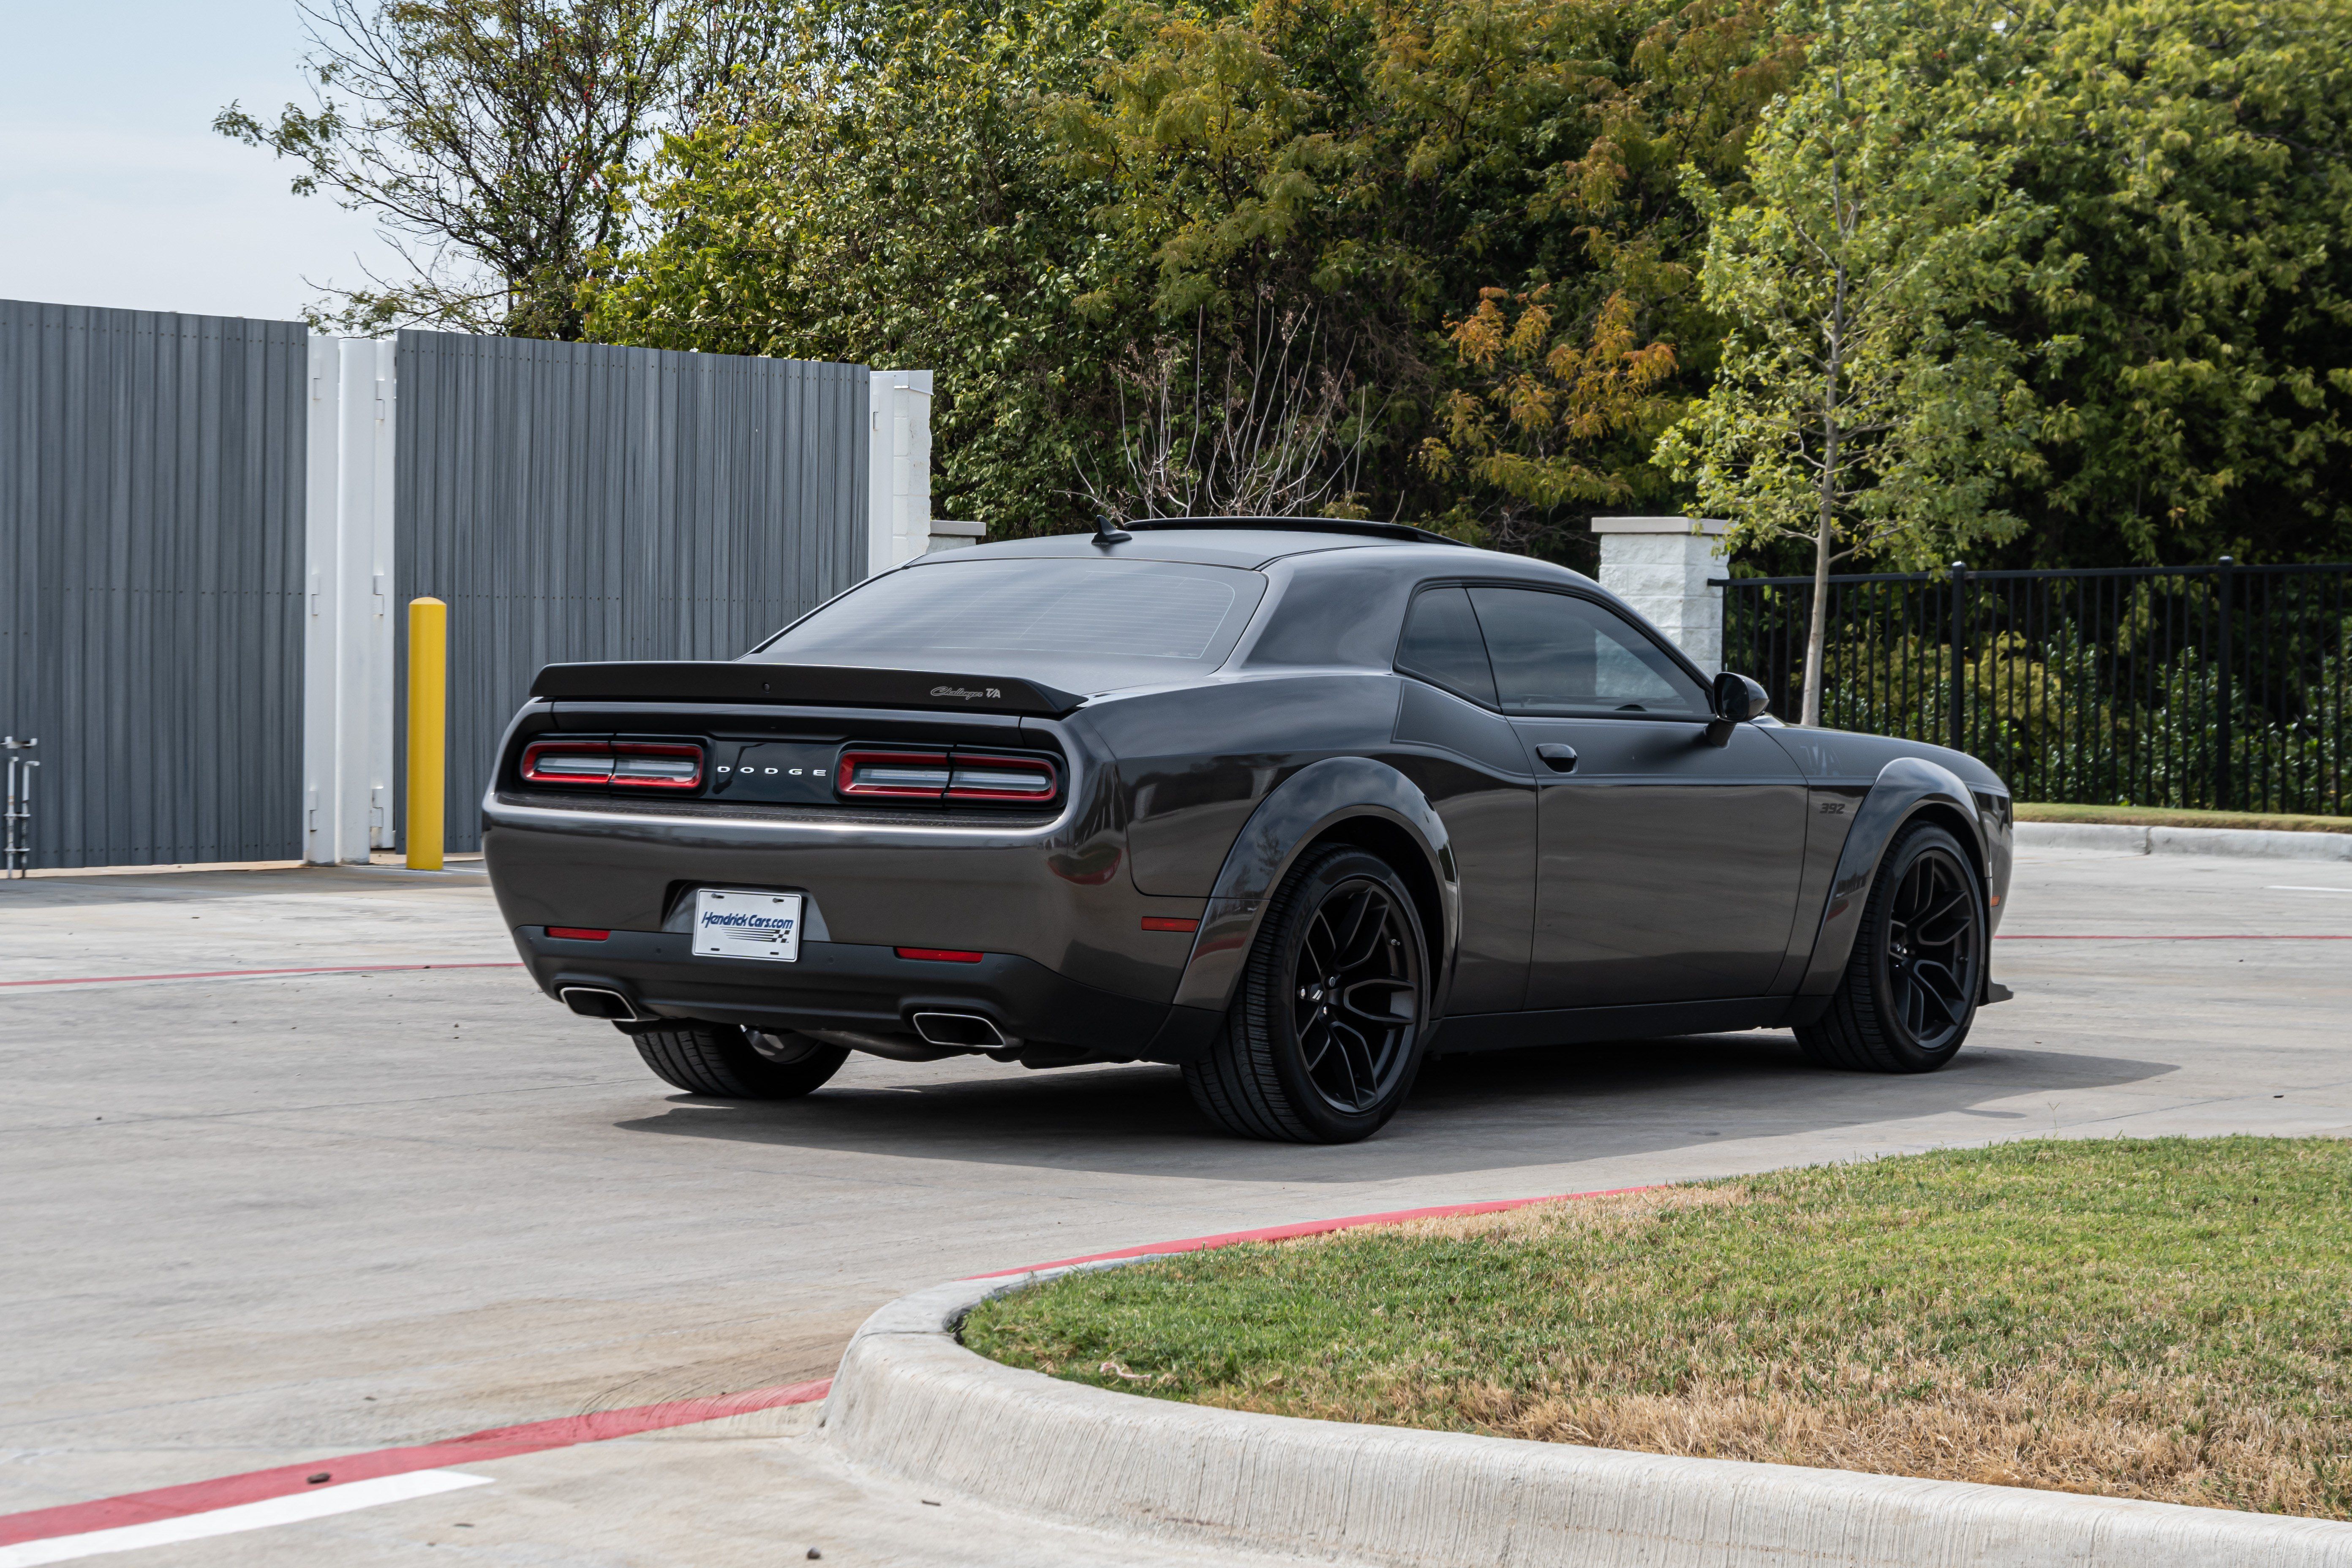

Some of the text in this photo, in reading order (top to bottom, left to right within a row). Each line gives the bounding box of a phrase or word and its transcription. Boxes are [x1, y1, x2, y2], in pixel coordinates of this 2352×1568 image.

[931, 686, 1001, 700] Challenger T/A
[717, 766, 827, 776] DODGE
[1819, 803, 1845, 814] 392
